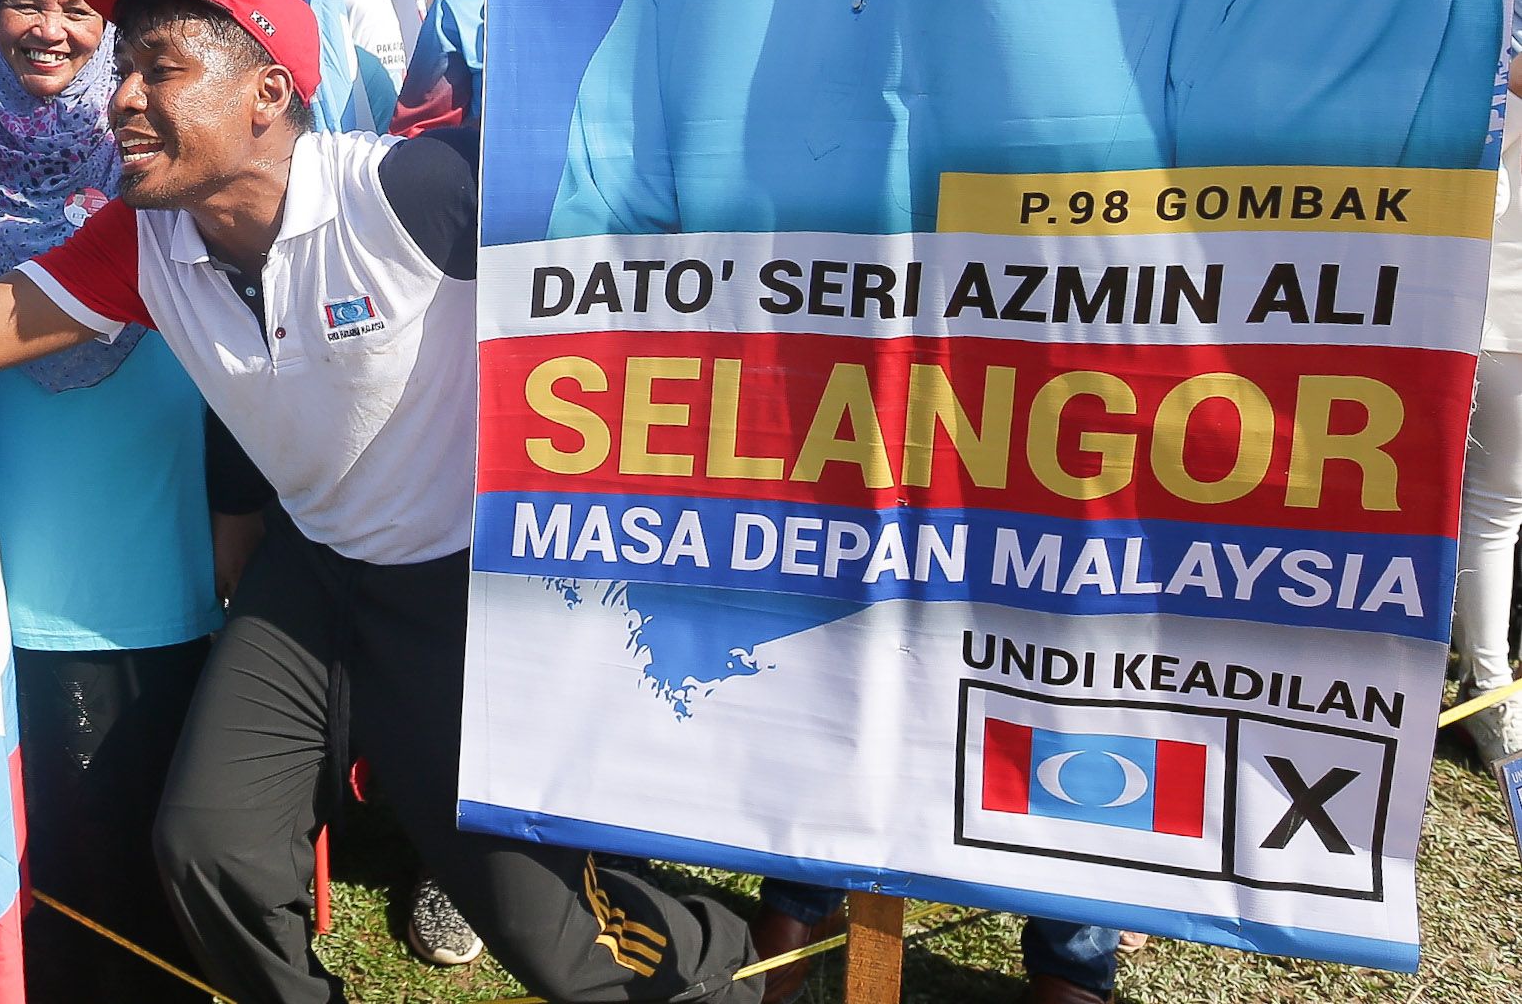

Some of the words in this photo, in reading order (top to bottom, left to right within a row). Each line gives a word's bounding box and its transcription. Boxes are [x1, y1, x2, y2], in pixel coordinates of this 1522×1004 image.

[1019, 190, 1130, 225] P.98
[1155, 185, 1412, 223] GOMBAK
[530, 259, 735, 318] DATO'
[759, 259, 922, 319] SERI
[943, 261, 1224, 325] AZMIN
[1245, 263, 1400, 325] ALI
[525, 355, 1405, 511] SELANGOR
[511, 502, 710, 568] MASA
[730, 512, 968, 584] DEPAN
[991, 527, 1424, 617] MALAYSIA
[962, 630, 1095, 688] UNDI
[1113, 653, 1405, 729] KEADILAN
[1259, 755, 1361, 855] X
